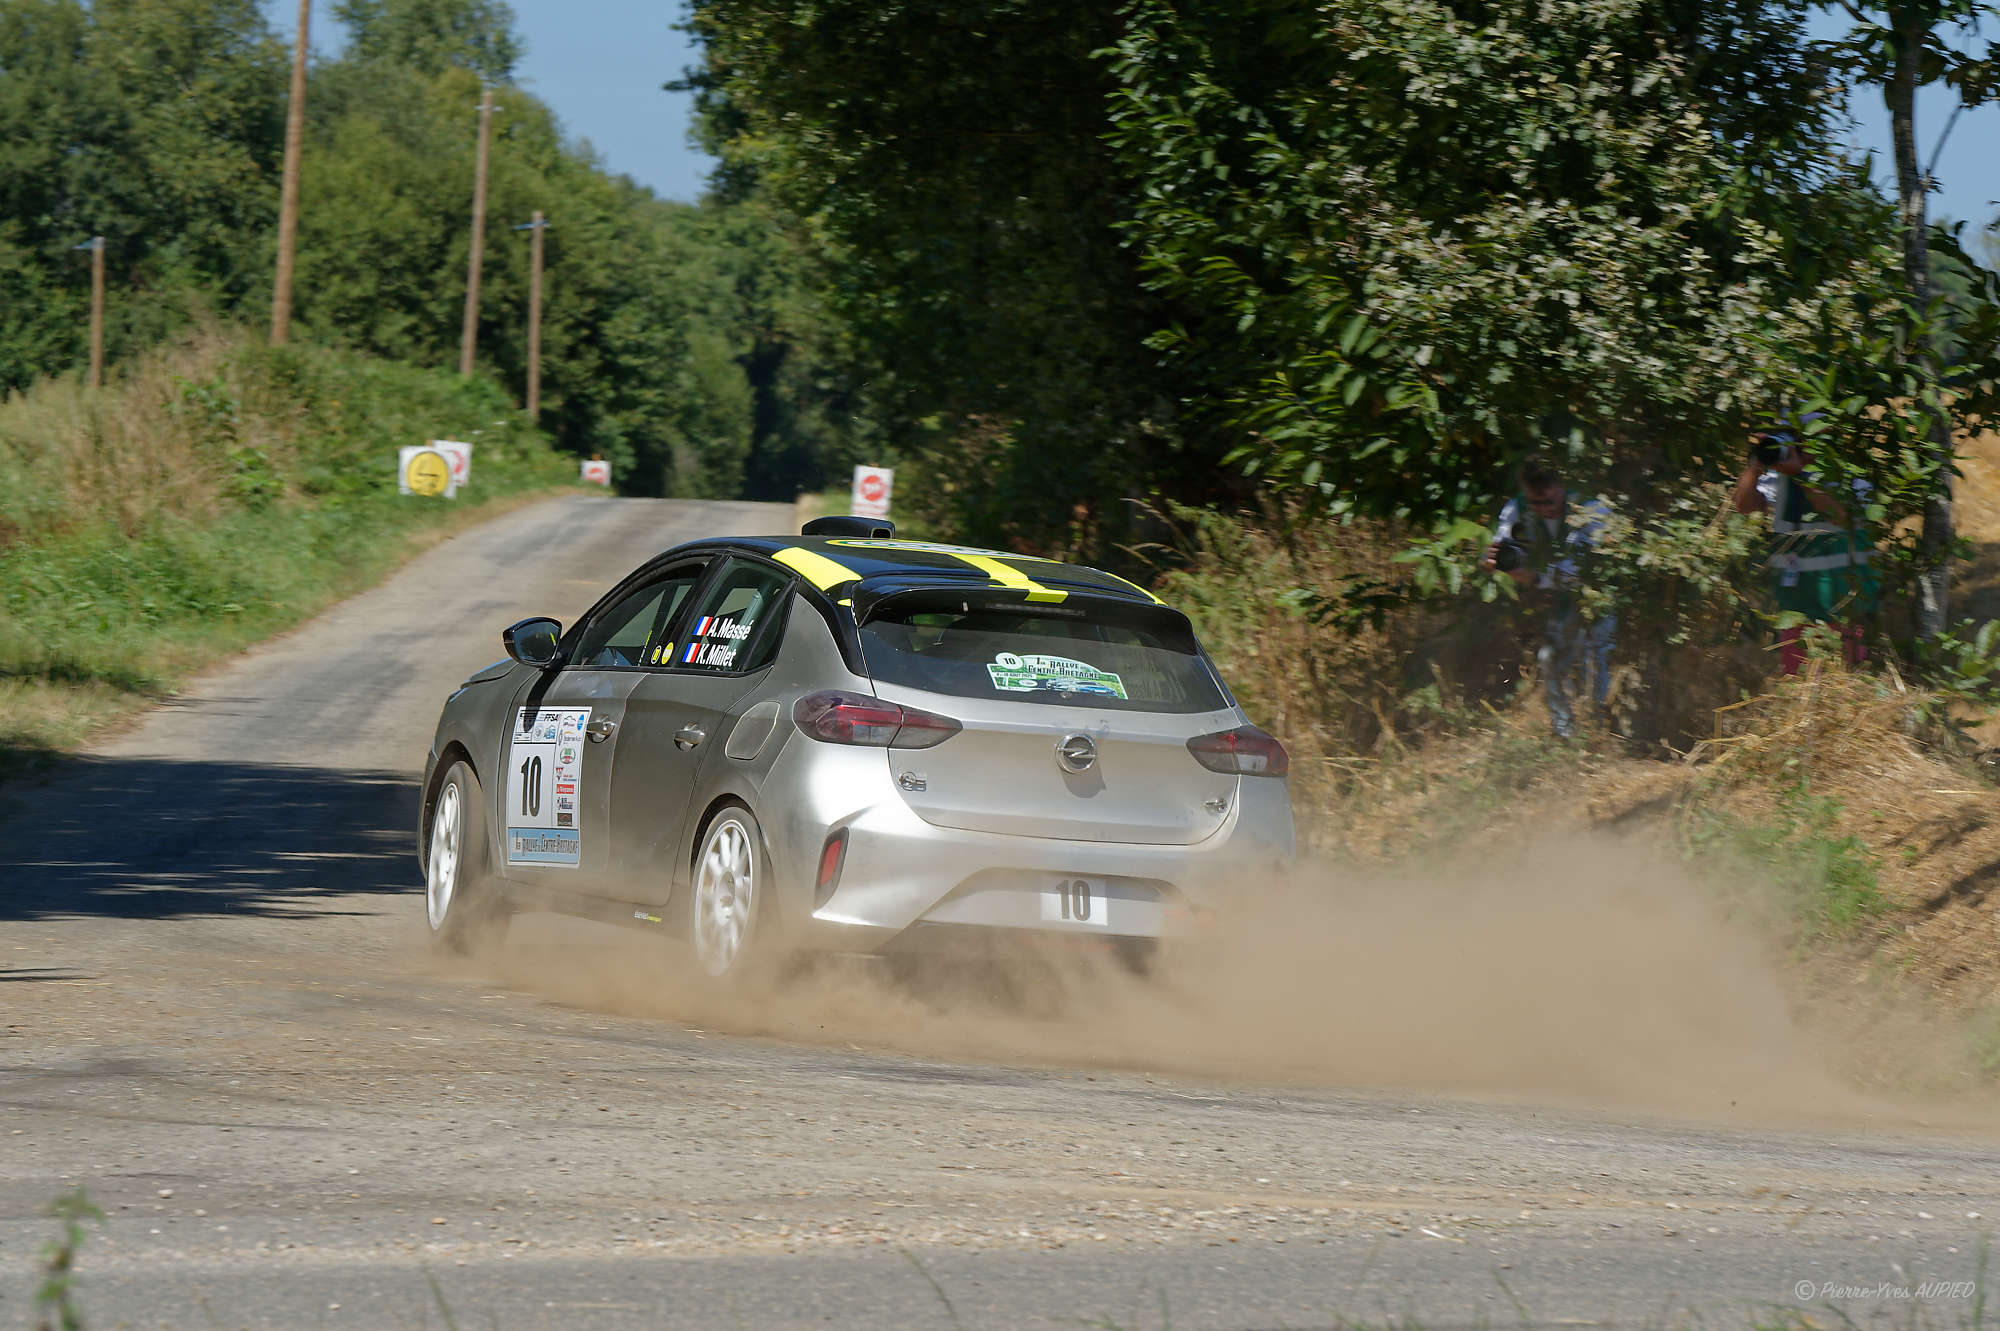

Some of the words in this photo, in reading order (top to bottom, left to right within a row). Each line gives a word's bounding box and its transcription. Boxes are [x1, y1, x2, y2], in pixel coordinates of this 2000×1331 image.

[706, 617, 754, 640] A.Massé
[695, 644, 737, 667] K.Millet
[544, 713, 559, 722] FFSA
[520, 755, 542, 817] 10
[1056, 880, 1091, 921] 10
